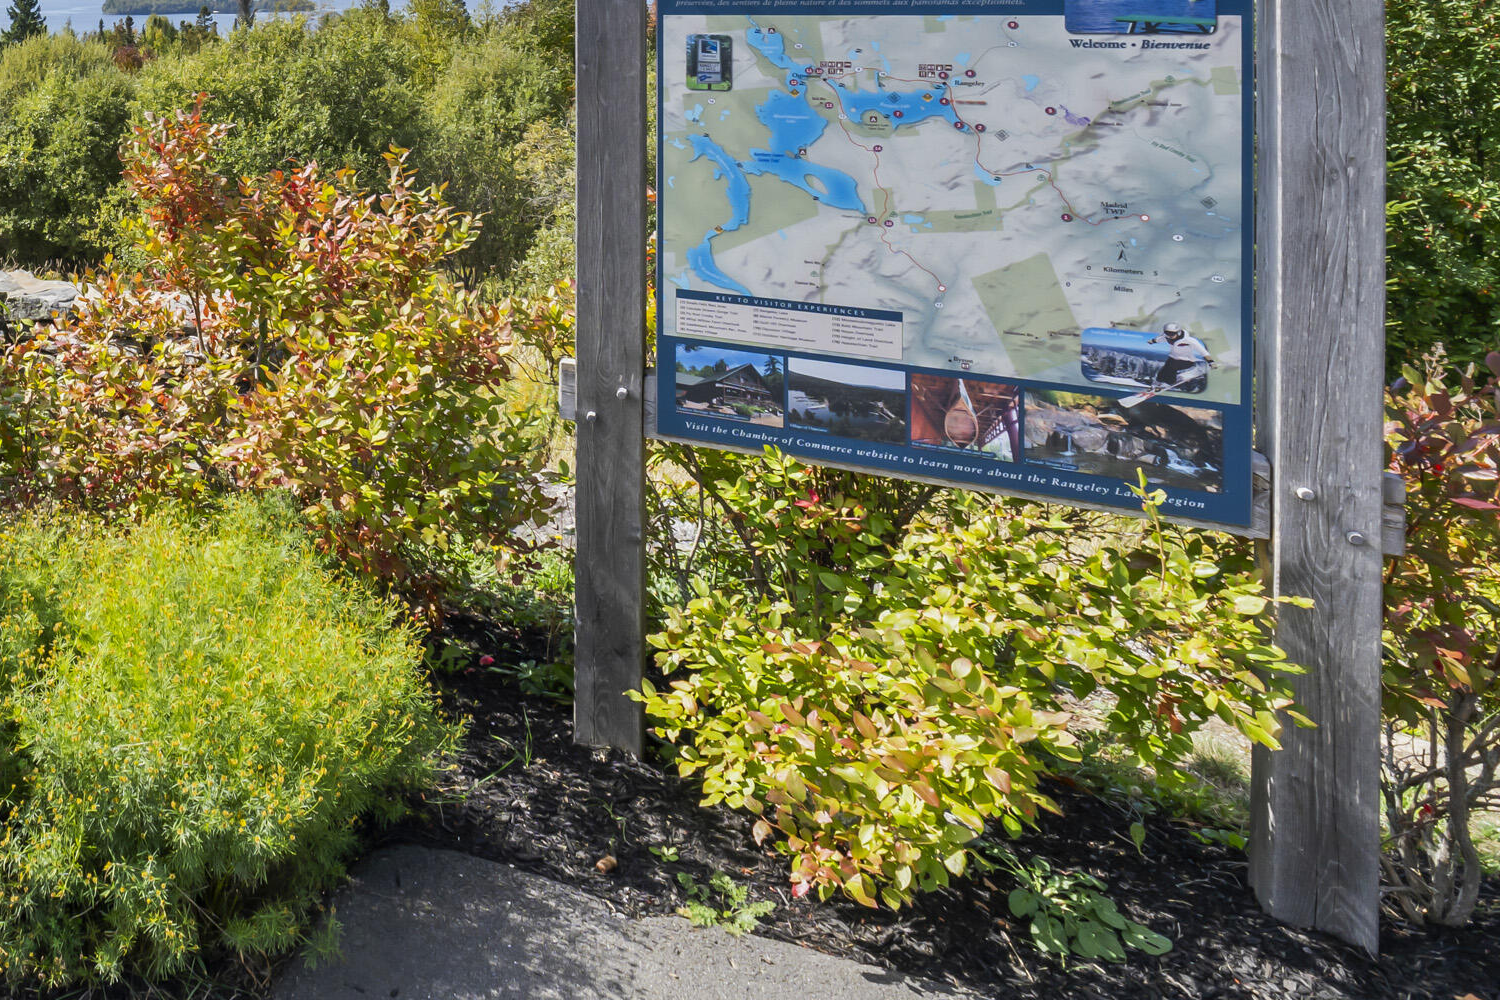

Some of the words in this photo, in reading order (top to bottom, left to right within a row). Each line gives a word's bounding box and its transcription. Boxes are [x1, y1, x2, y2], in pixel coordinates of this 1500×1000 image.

[1069, 39, 1126, 48] Welcome
[1141, 40, 1210, 49] Bienvenue
[1103, 267, 1144, 275] Kilometers
[1113, 285, 1134, 293] Miles
[754, 300, 791, 308] VISITOR
[798, 304, 865, 317] EXPERIENCES
[686, 422, 708, 431] Visit
[713, 426, 727, 434] the
[732, 429, 779, 443] Chamber
[782, 437, 793, 446] of
[797, 439, 852, 453] Commerce
[857, 450, 898, 460] website
[919, 457, 949, 469] learn
[954, 465, 982, 473] more
[988, 469, 1022, 480] about
[1028, 475, 1046, 483] the
[1052, 478, 1109, 495] Rangeley
[1164, 497, 1205, 509] egion
